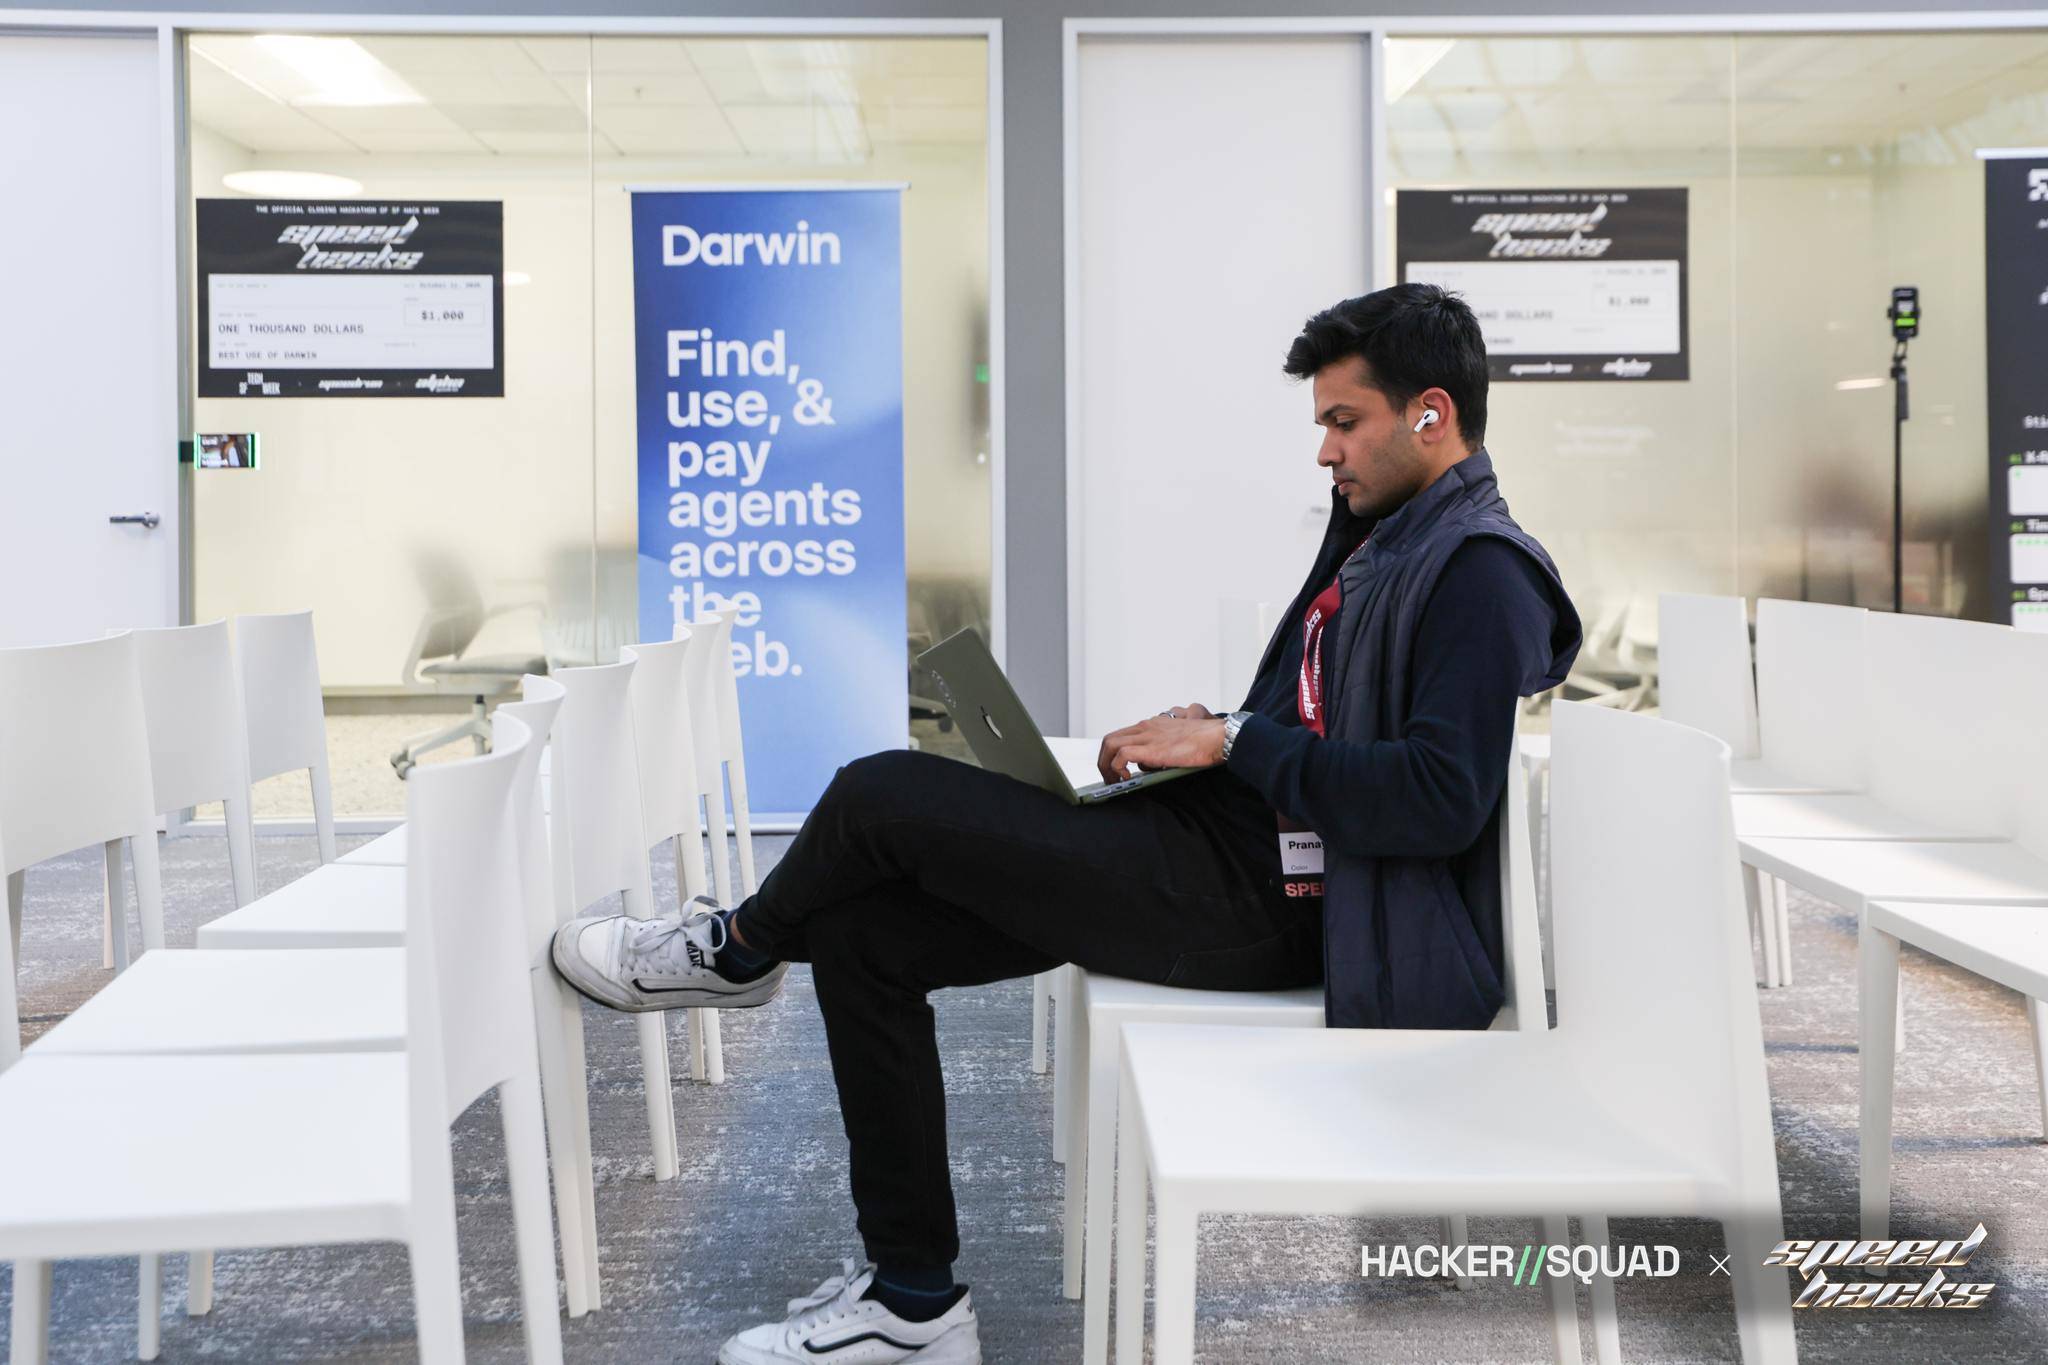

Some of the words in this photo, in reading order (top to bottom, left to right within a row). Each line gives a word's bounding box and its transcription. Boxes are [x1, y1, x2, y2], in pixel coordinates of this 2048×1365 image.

[277, 215, 419, 251] speed
[663, 221, 842, 265] Darwin
[296, 243, 424, 269] hacks
[218, 324, 240, 334] ONE
[249, 324, 306, 334] THOUSAND
[313, 324, 364, 334] DOLLARS
[421, 310, 464, 321] $1,000
[218, 352, 239, 360] BEST
[267, 352, 278, 360] OF
[284, 352, 318, 360] DARWIN
[667, 327, 799, 384] Find,
[667, 389, 780, 434] use,
[793, 379, 835, 425] &
[668, 440, 771, 487] pay
[668, 483, 862, 538] agents
[669, 538, 856, 578] across
[731, 631, 802, 677] eb.
[1285, 882, 1325, 897] SPE
